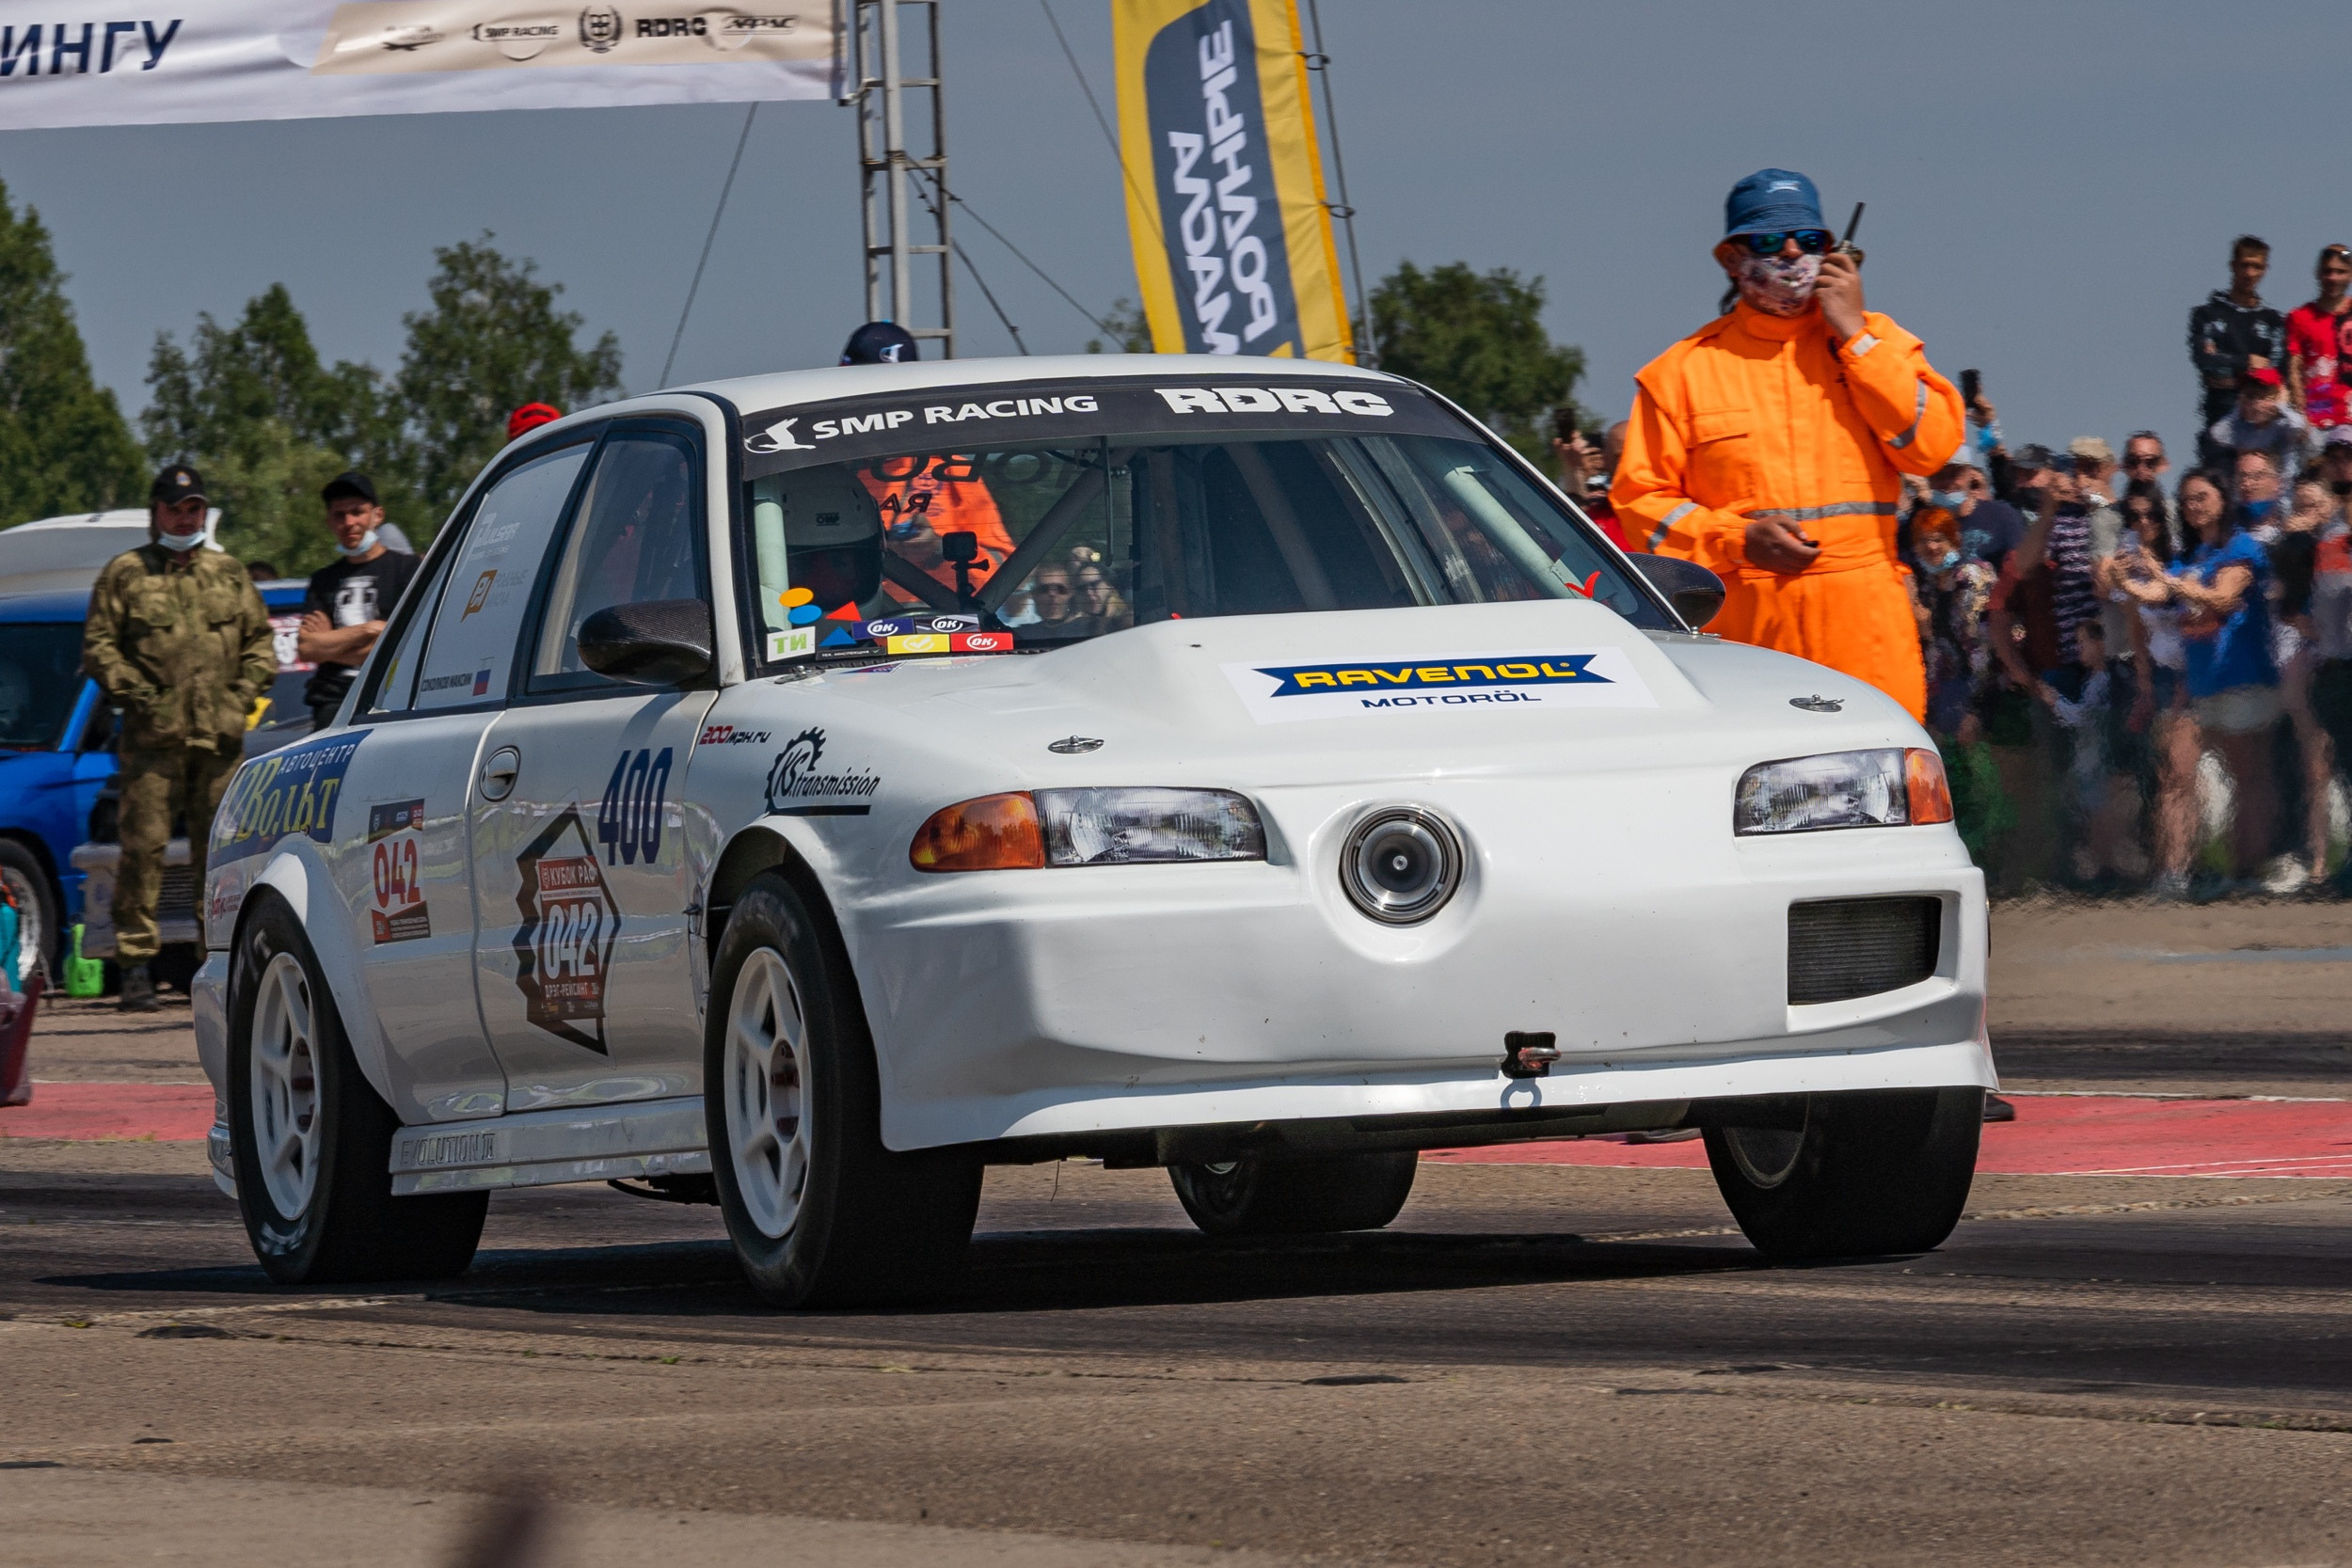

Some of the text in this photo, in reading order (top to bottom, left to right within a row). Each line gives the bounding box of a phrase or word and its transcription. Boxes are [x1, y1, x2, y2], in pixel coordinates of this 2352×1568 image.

[514, 25, 559, 37] RACING
[635, 17, 707, 38] RDRC
[1153, 388, 1394, 417] RDRC
[812, 395, 1099, 440] SMP RACING
[772, 633, 807, 655] ТИ
[1293, 663, 1577, 688] RAVENOL
[1360, 689, 1542, 708] MOTORÖL
[278, 743, 356, 775] АВТОЦЕНТР
[597, 747, 673, 865] 400
[373, 838, 421, 909] 042
[549, 864, 598, 886] КУБОК РАФ
[544, 901, 597, 979] 042
[545, 981, 588, 1000] ДРЭГ-РЕЙСИНГ
[400, 1133, 479, 1166] EVOLUTION
